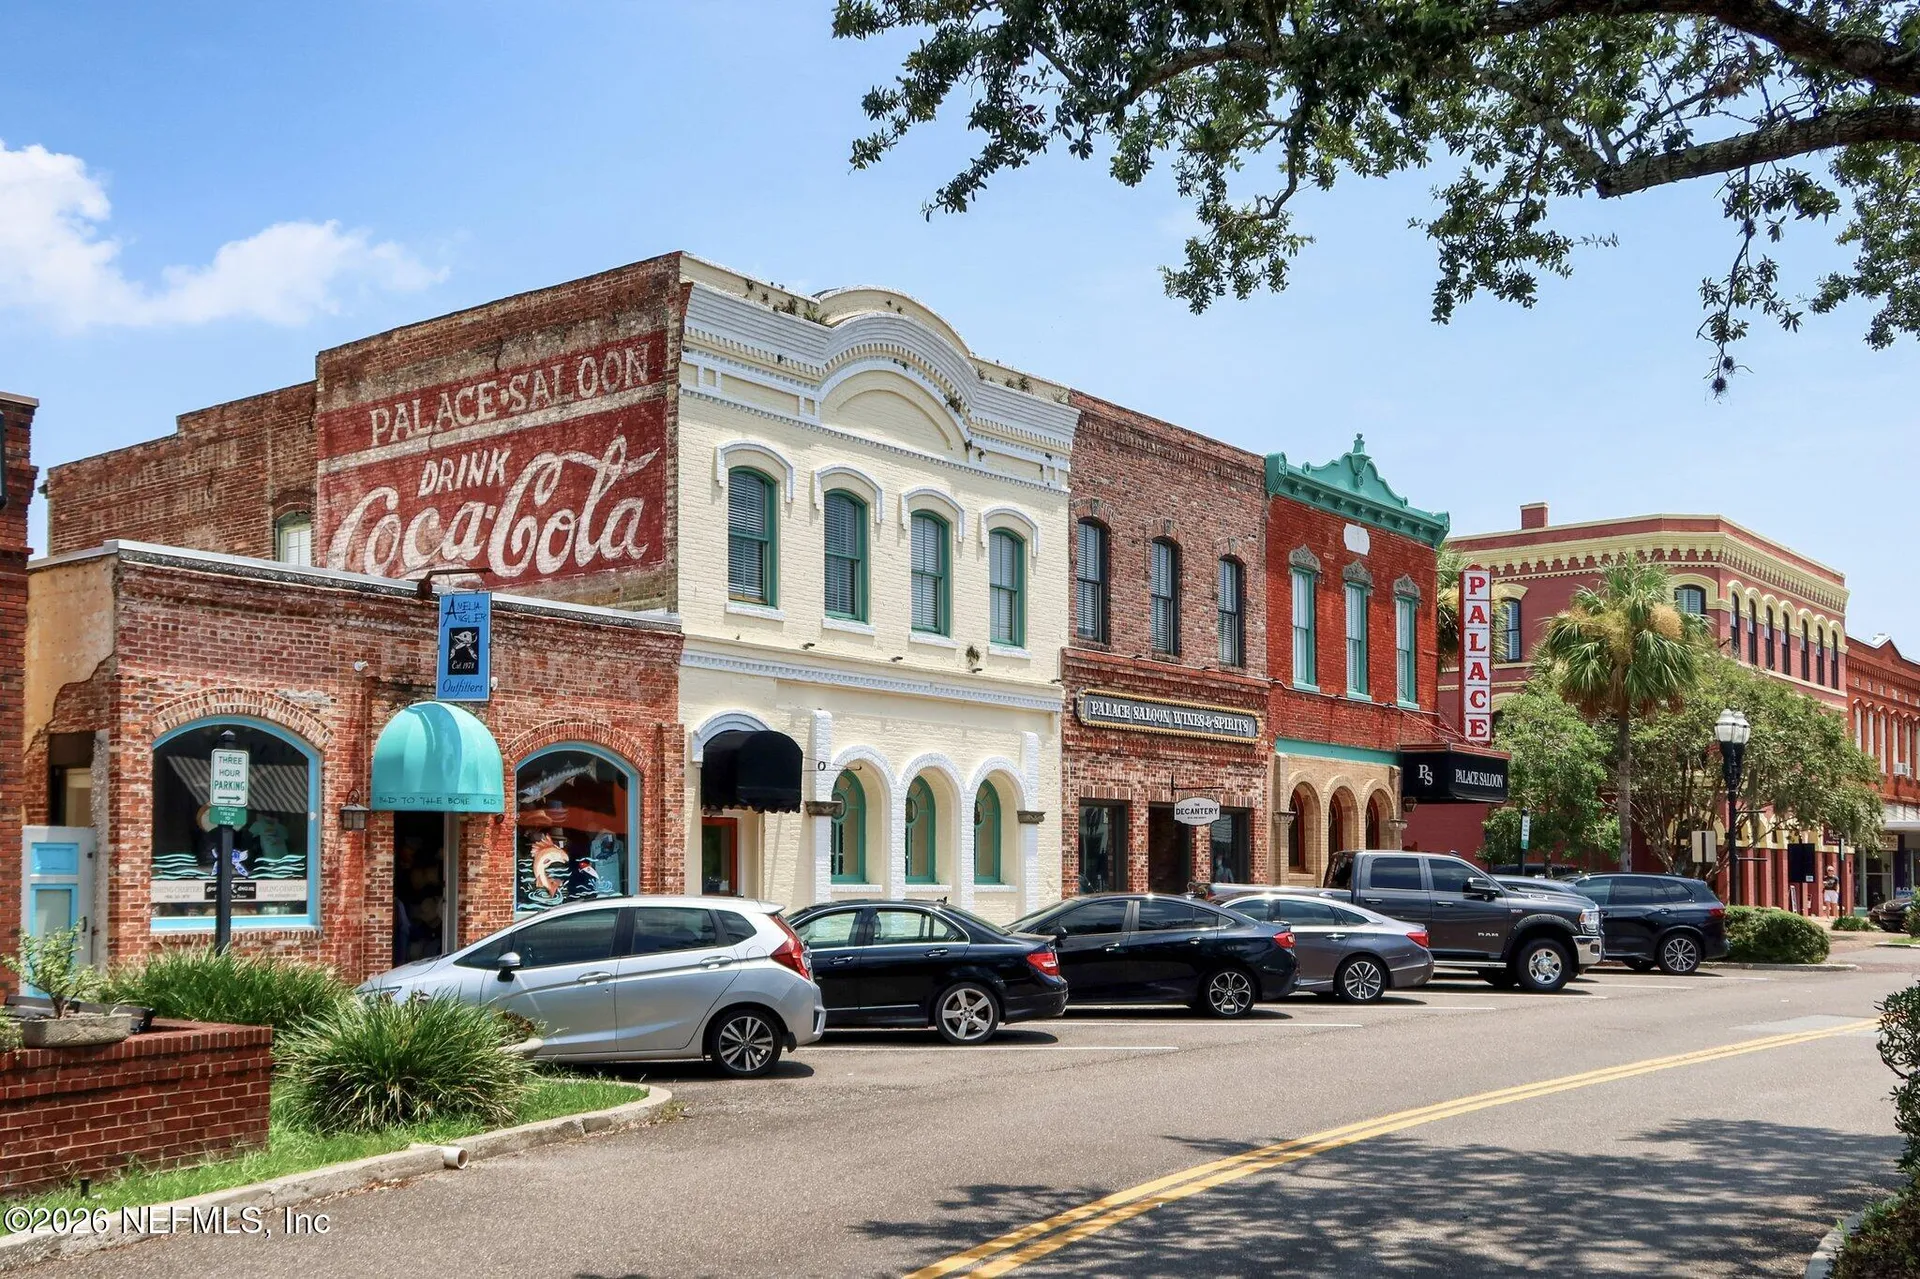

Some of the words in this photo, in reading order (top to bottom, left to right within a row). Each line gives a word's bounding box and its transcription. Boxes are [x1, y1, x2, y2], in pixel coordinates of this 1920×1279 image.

[369, 379, 497, 448] PALACE
[508, 343, 651, 413] SALOON
[417, 447, 512, 499] DRINK
[325, 433, 661, 580] Coca-Cola
[1467, 576, 1488, 738] PALACE
[442, 678, 483, 697] Outfitters
[1090, 700, 1131, 719] PALACE
[1133, 706, 1170, 724] SALOON
[1172, 710, 1205, 727] WINES
[1213, 715, 1249, 732] SPIRITS
[218, 756, 243, 765] THREE
[219, 769, 241, 777] HOUR
[1455, 768, 1479, 785] PALACE
[1479, 772, 1504, 788] SALOON
[214, 780, 245, 791] PARKING
[1175, 807, 1219, 815] DECANTERY
